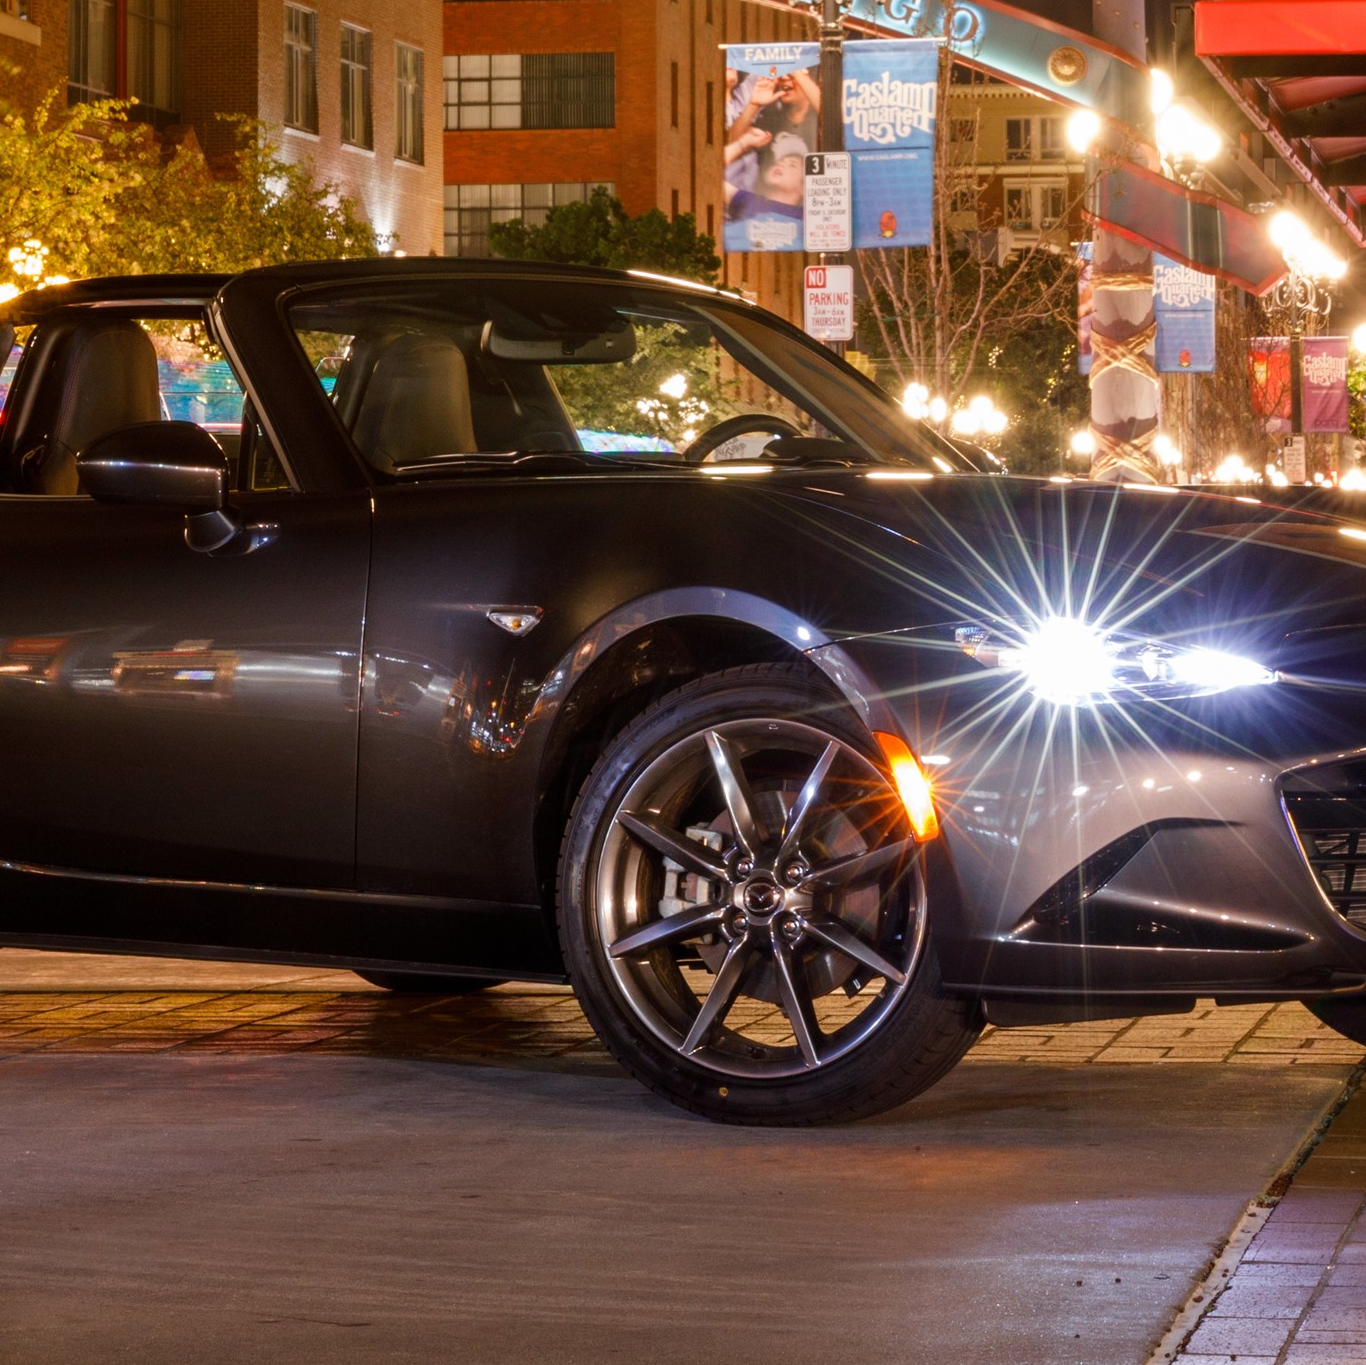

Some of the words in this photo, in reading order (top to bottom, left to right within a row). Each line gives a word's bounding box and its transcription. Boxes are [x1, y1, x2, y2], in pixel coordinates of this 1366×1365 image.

[744, 47, 803, 61] FAMILY
[842, 71, 937, 125] Gaslamp
[853, 107, 933, 145] Quarter
[811, 157, 820, 173] 3
[826, 159, 847, 169] MINUTE
[811, 177, 842, 186] PASSENGER
[808, 188, 830, 197] LOADING
[833, 188, 846, 196] ONLY
[808, 270, 824, 286] NO
[809, 293, 849, 305] PARKING
[812, 317, 846, 326] THURSDAY
